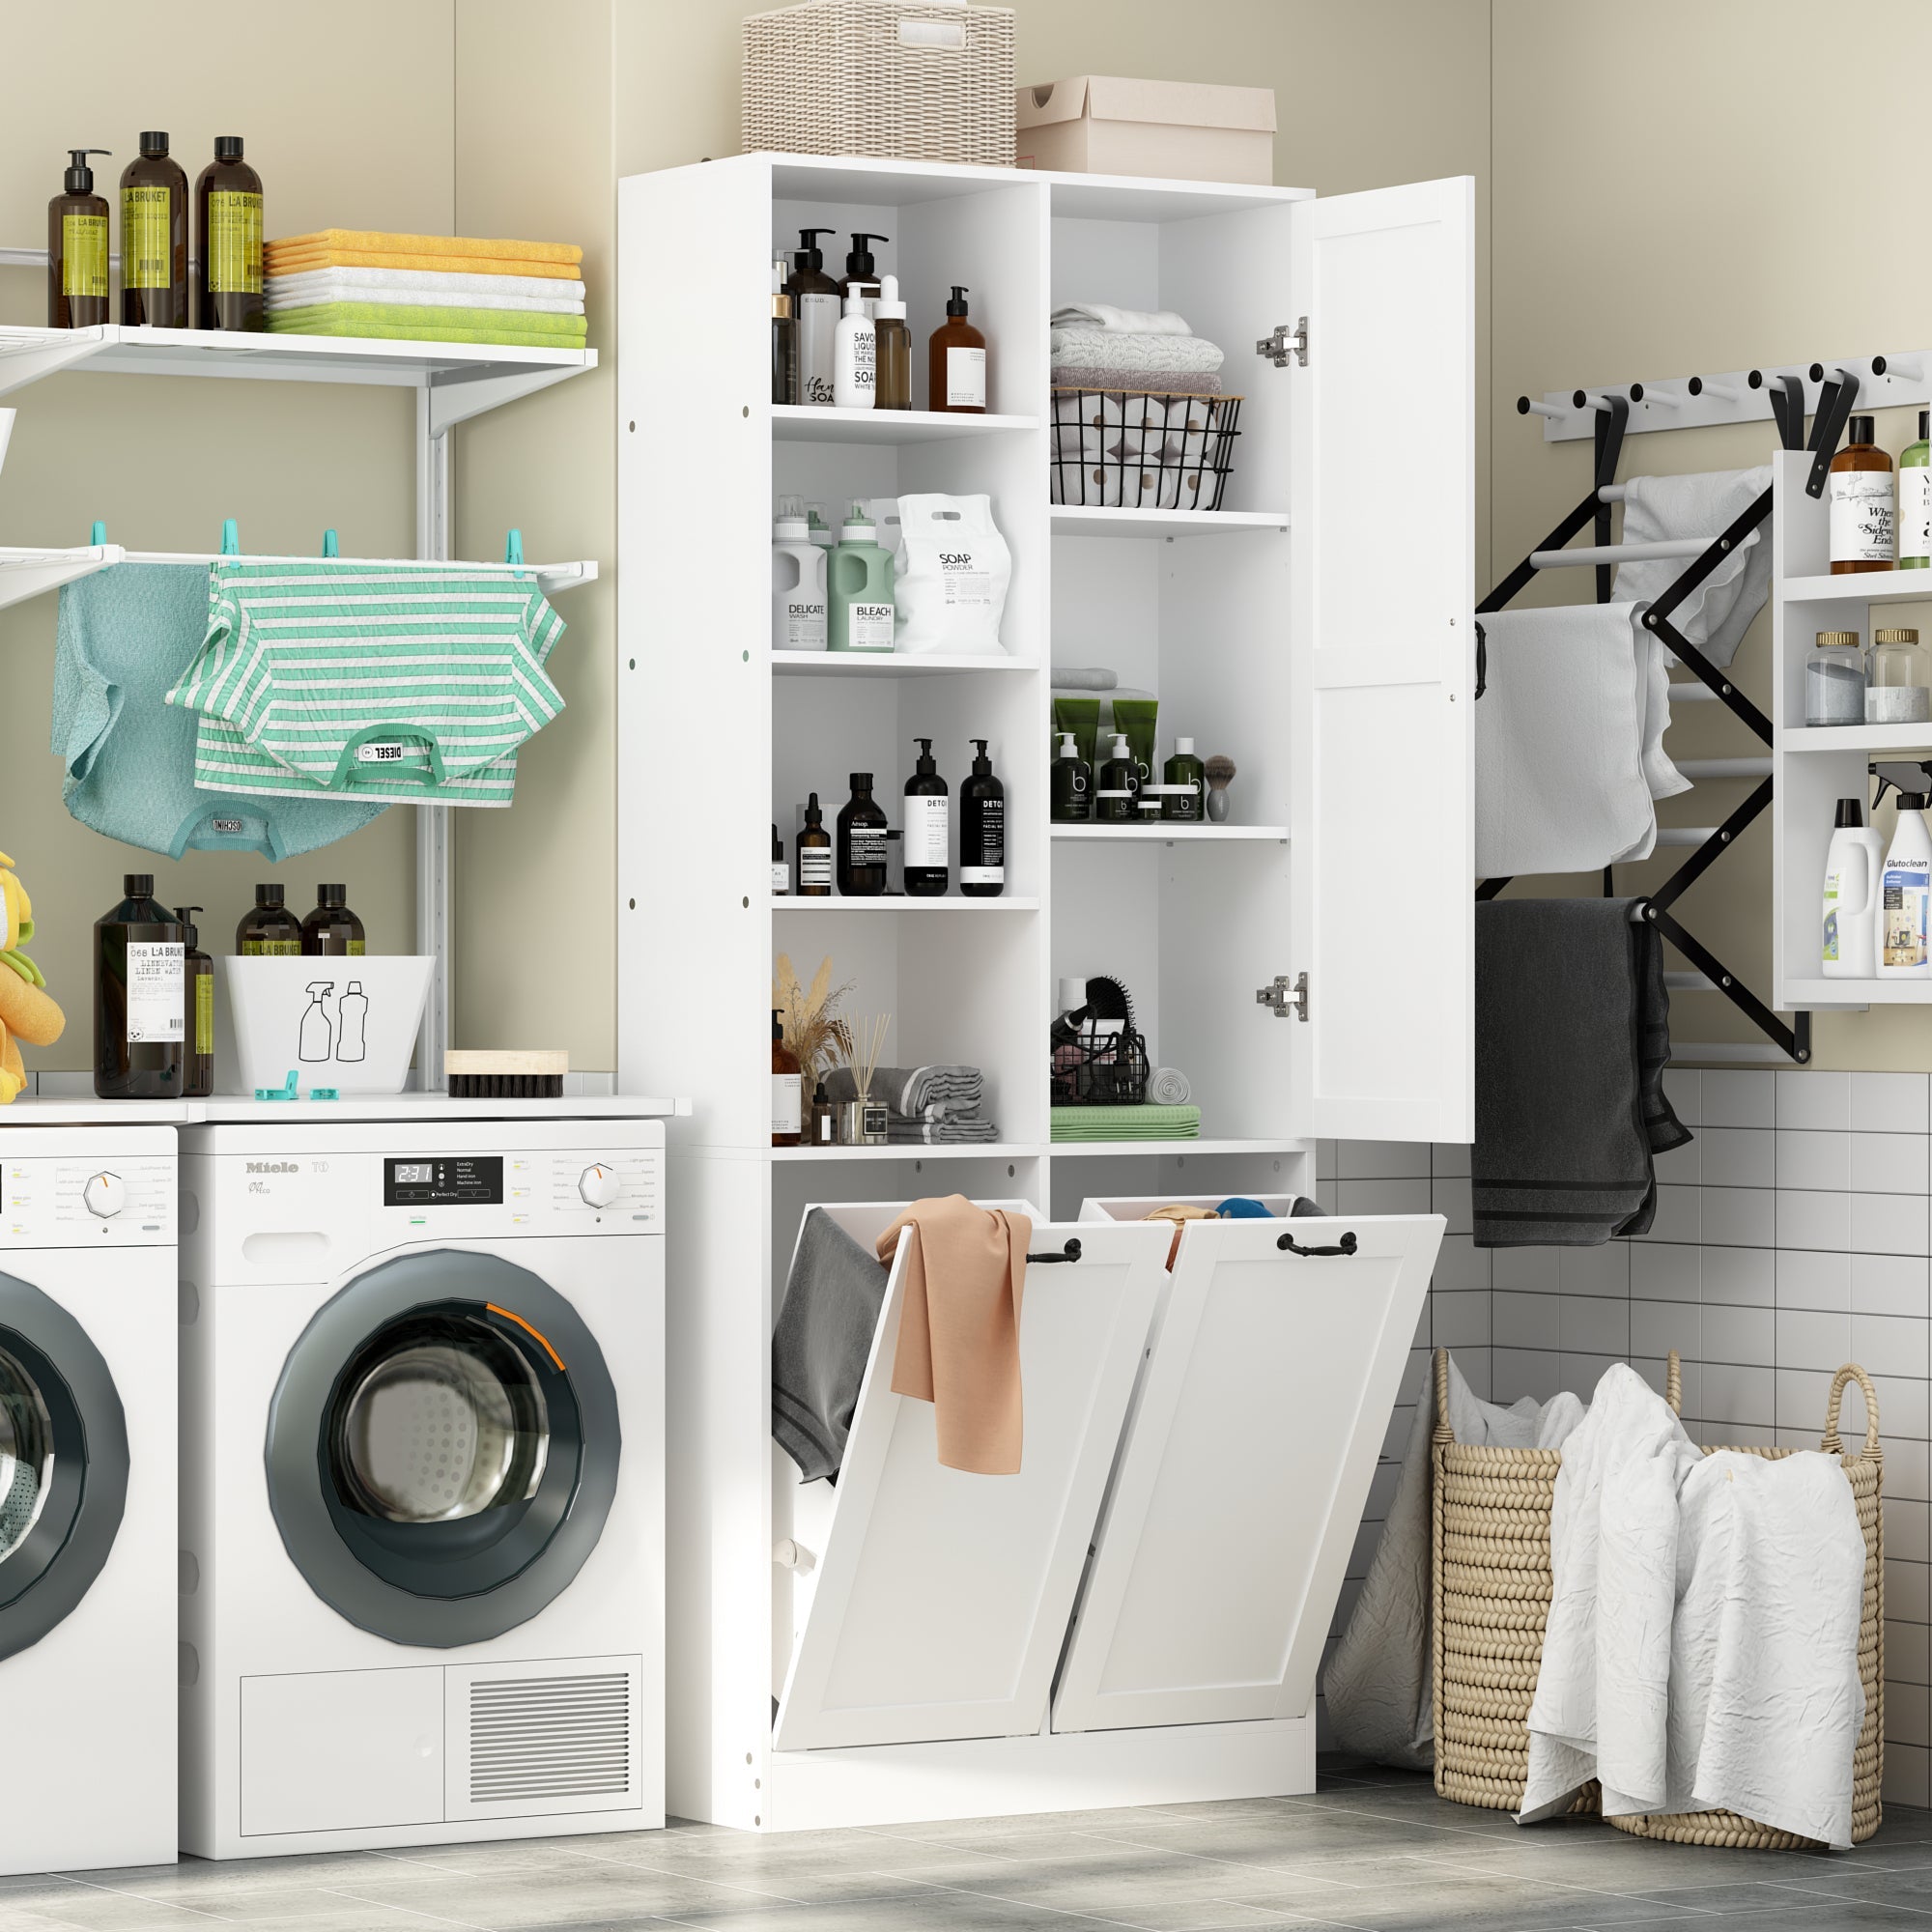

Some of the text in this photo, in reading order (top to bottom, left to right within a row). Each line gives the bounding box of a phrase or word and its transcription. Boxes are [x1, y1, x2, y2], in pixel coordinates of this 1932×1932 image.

[135, 191, 166, 203] BRUKET
[854, 332, 875, 343] SAVO
[804, 376, 835, 394] Han
[810, 393, 835, 402] SOA
[1878, 518, 1891, 526] the
[939, 554, 972, 564] SOAP
[788, 604, 824, 614] DELICATE
[857, 607, 891, 616] BLEACH
[375, 746, 401, 758] DIESEL
[1072, 770, 1086, 792] b
[1887, 859, 1928, 867] Glutoclean
[130, 949, 148, 957] 068
[245, 1162, 299, 1174] Miele
[398, 1166, 431, 1181] 2:31
